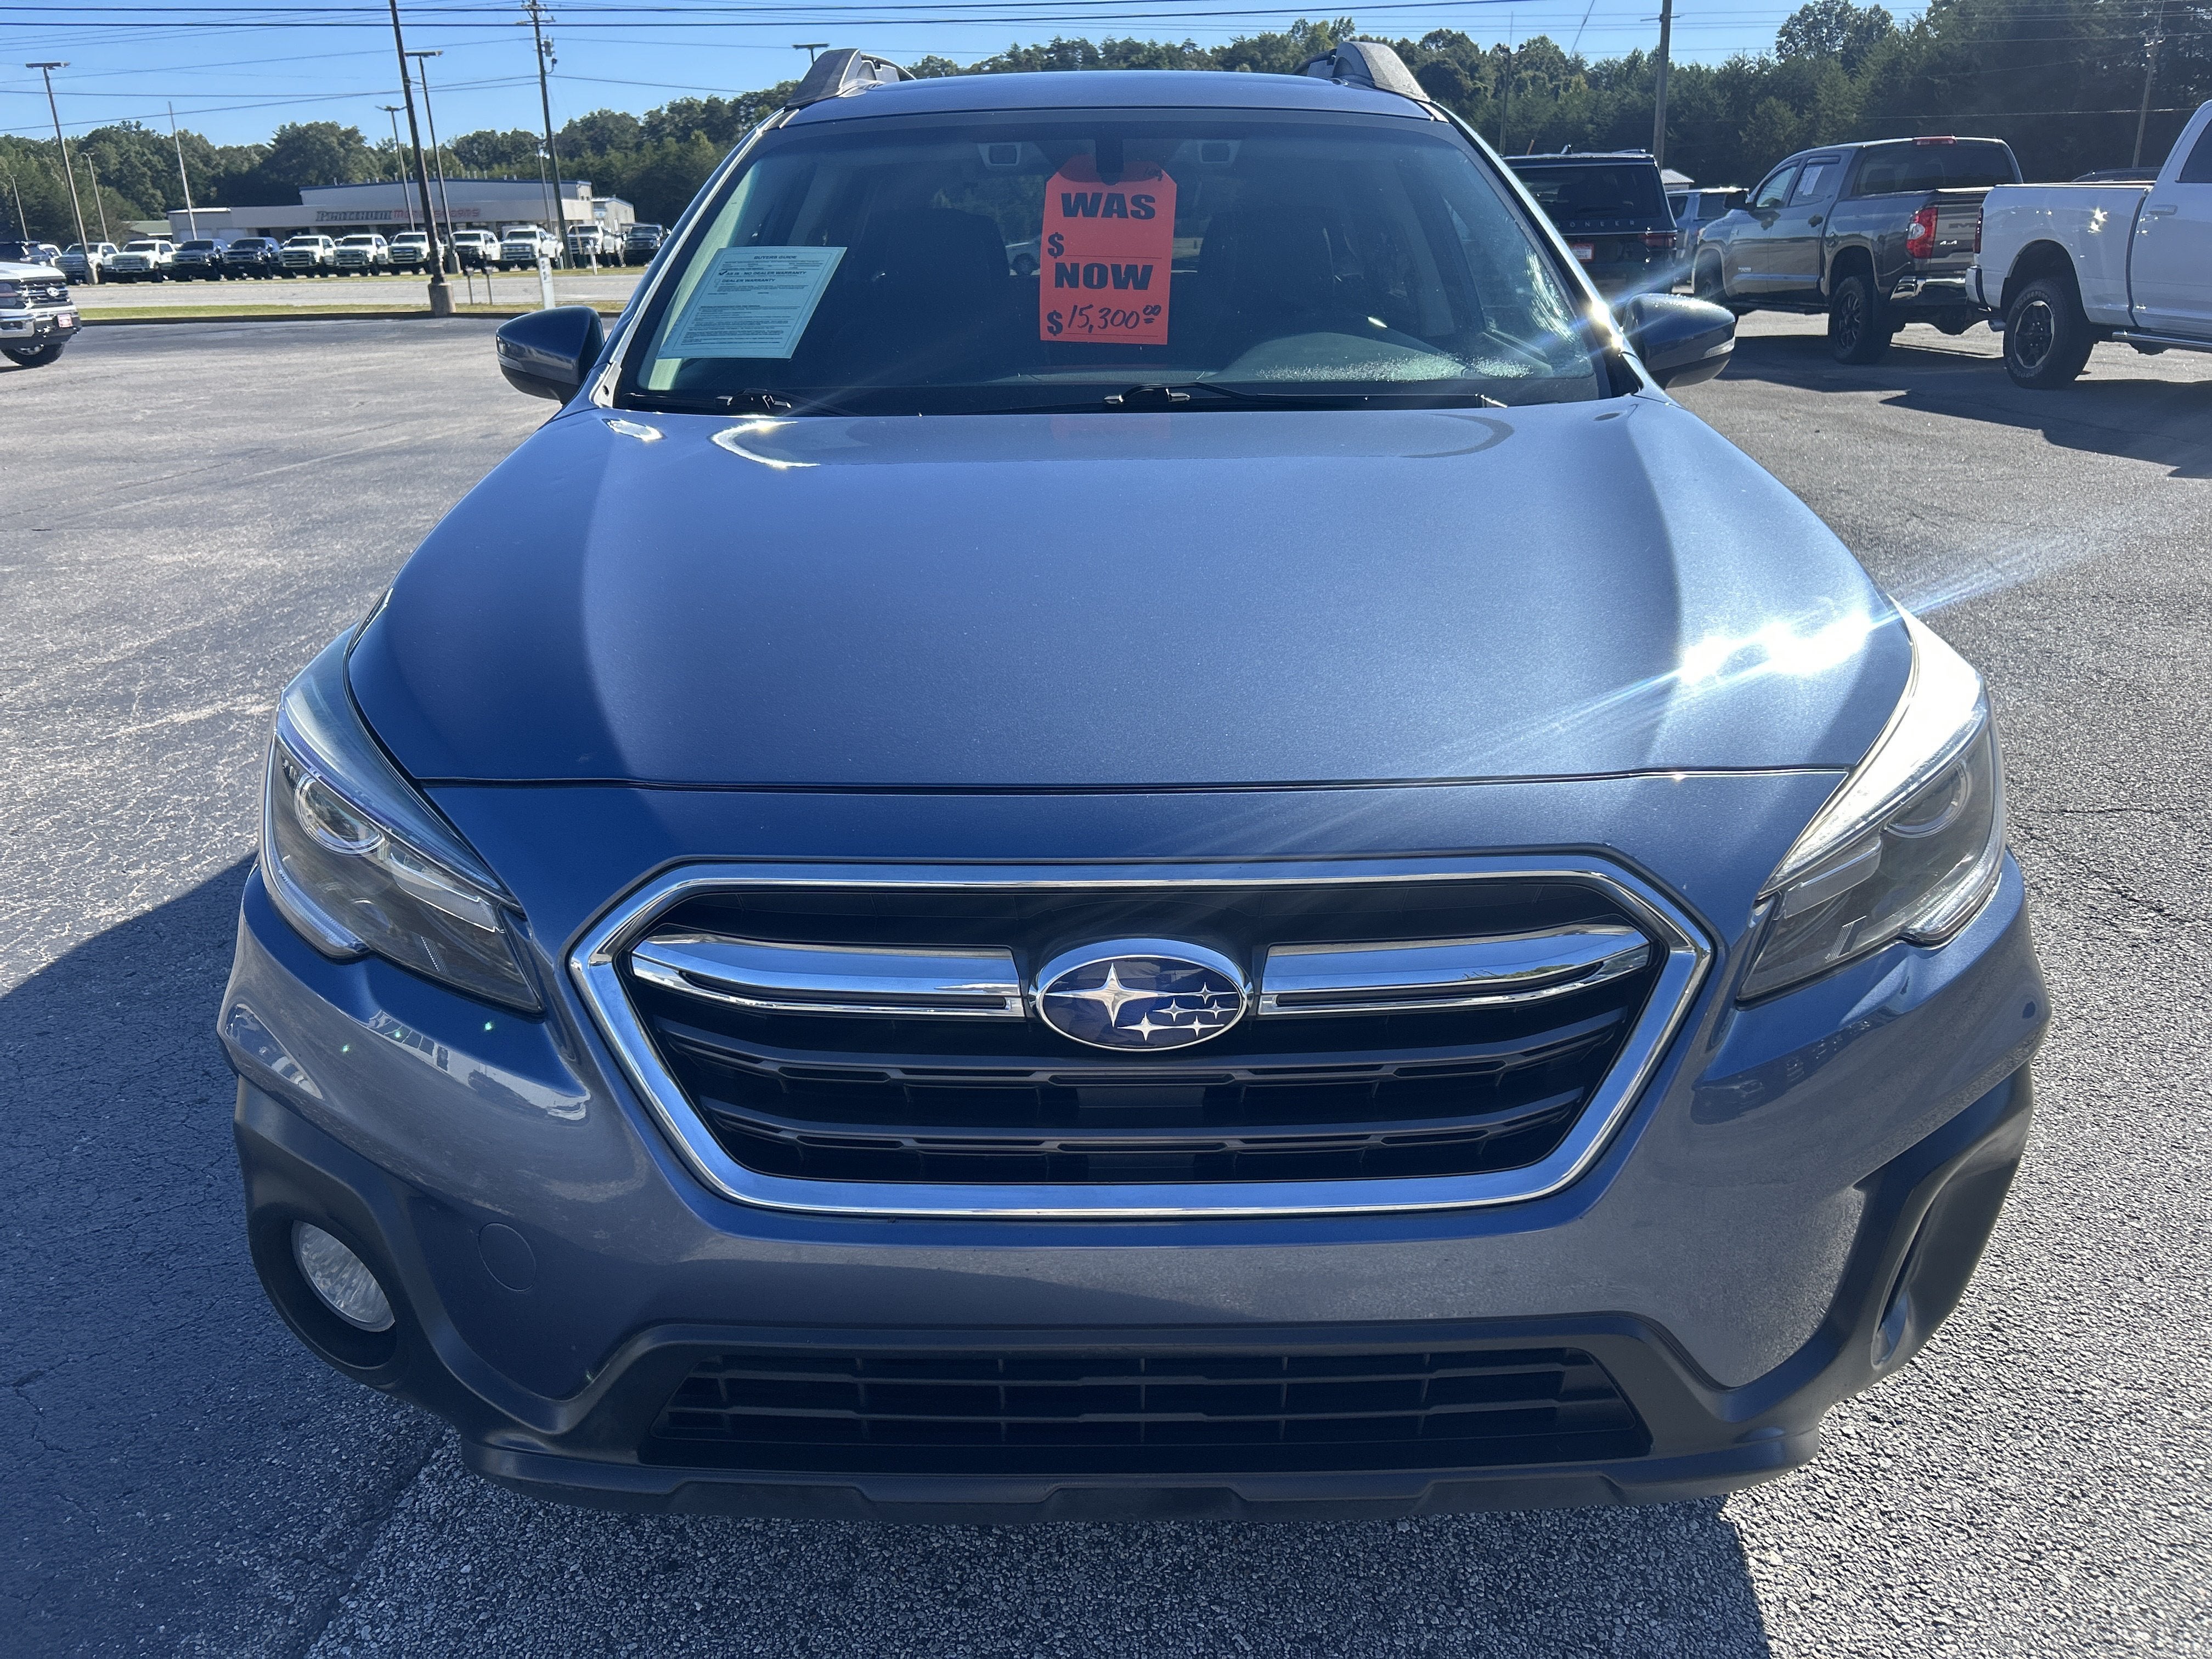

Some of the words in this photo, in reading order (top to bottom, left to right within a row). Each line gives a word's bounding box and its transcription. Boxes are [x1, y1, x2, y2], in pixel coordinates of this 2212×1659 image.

[1061, 192, 1155, 219] WAS
[1047, 232, 1064, 259] $
[1054, 262, 1153, 290] NOW
[1047, 310, 1063, 336] $
